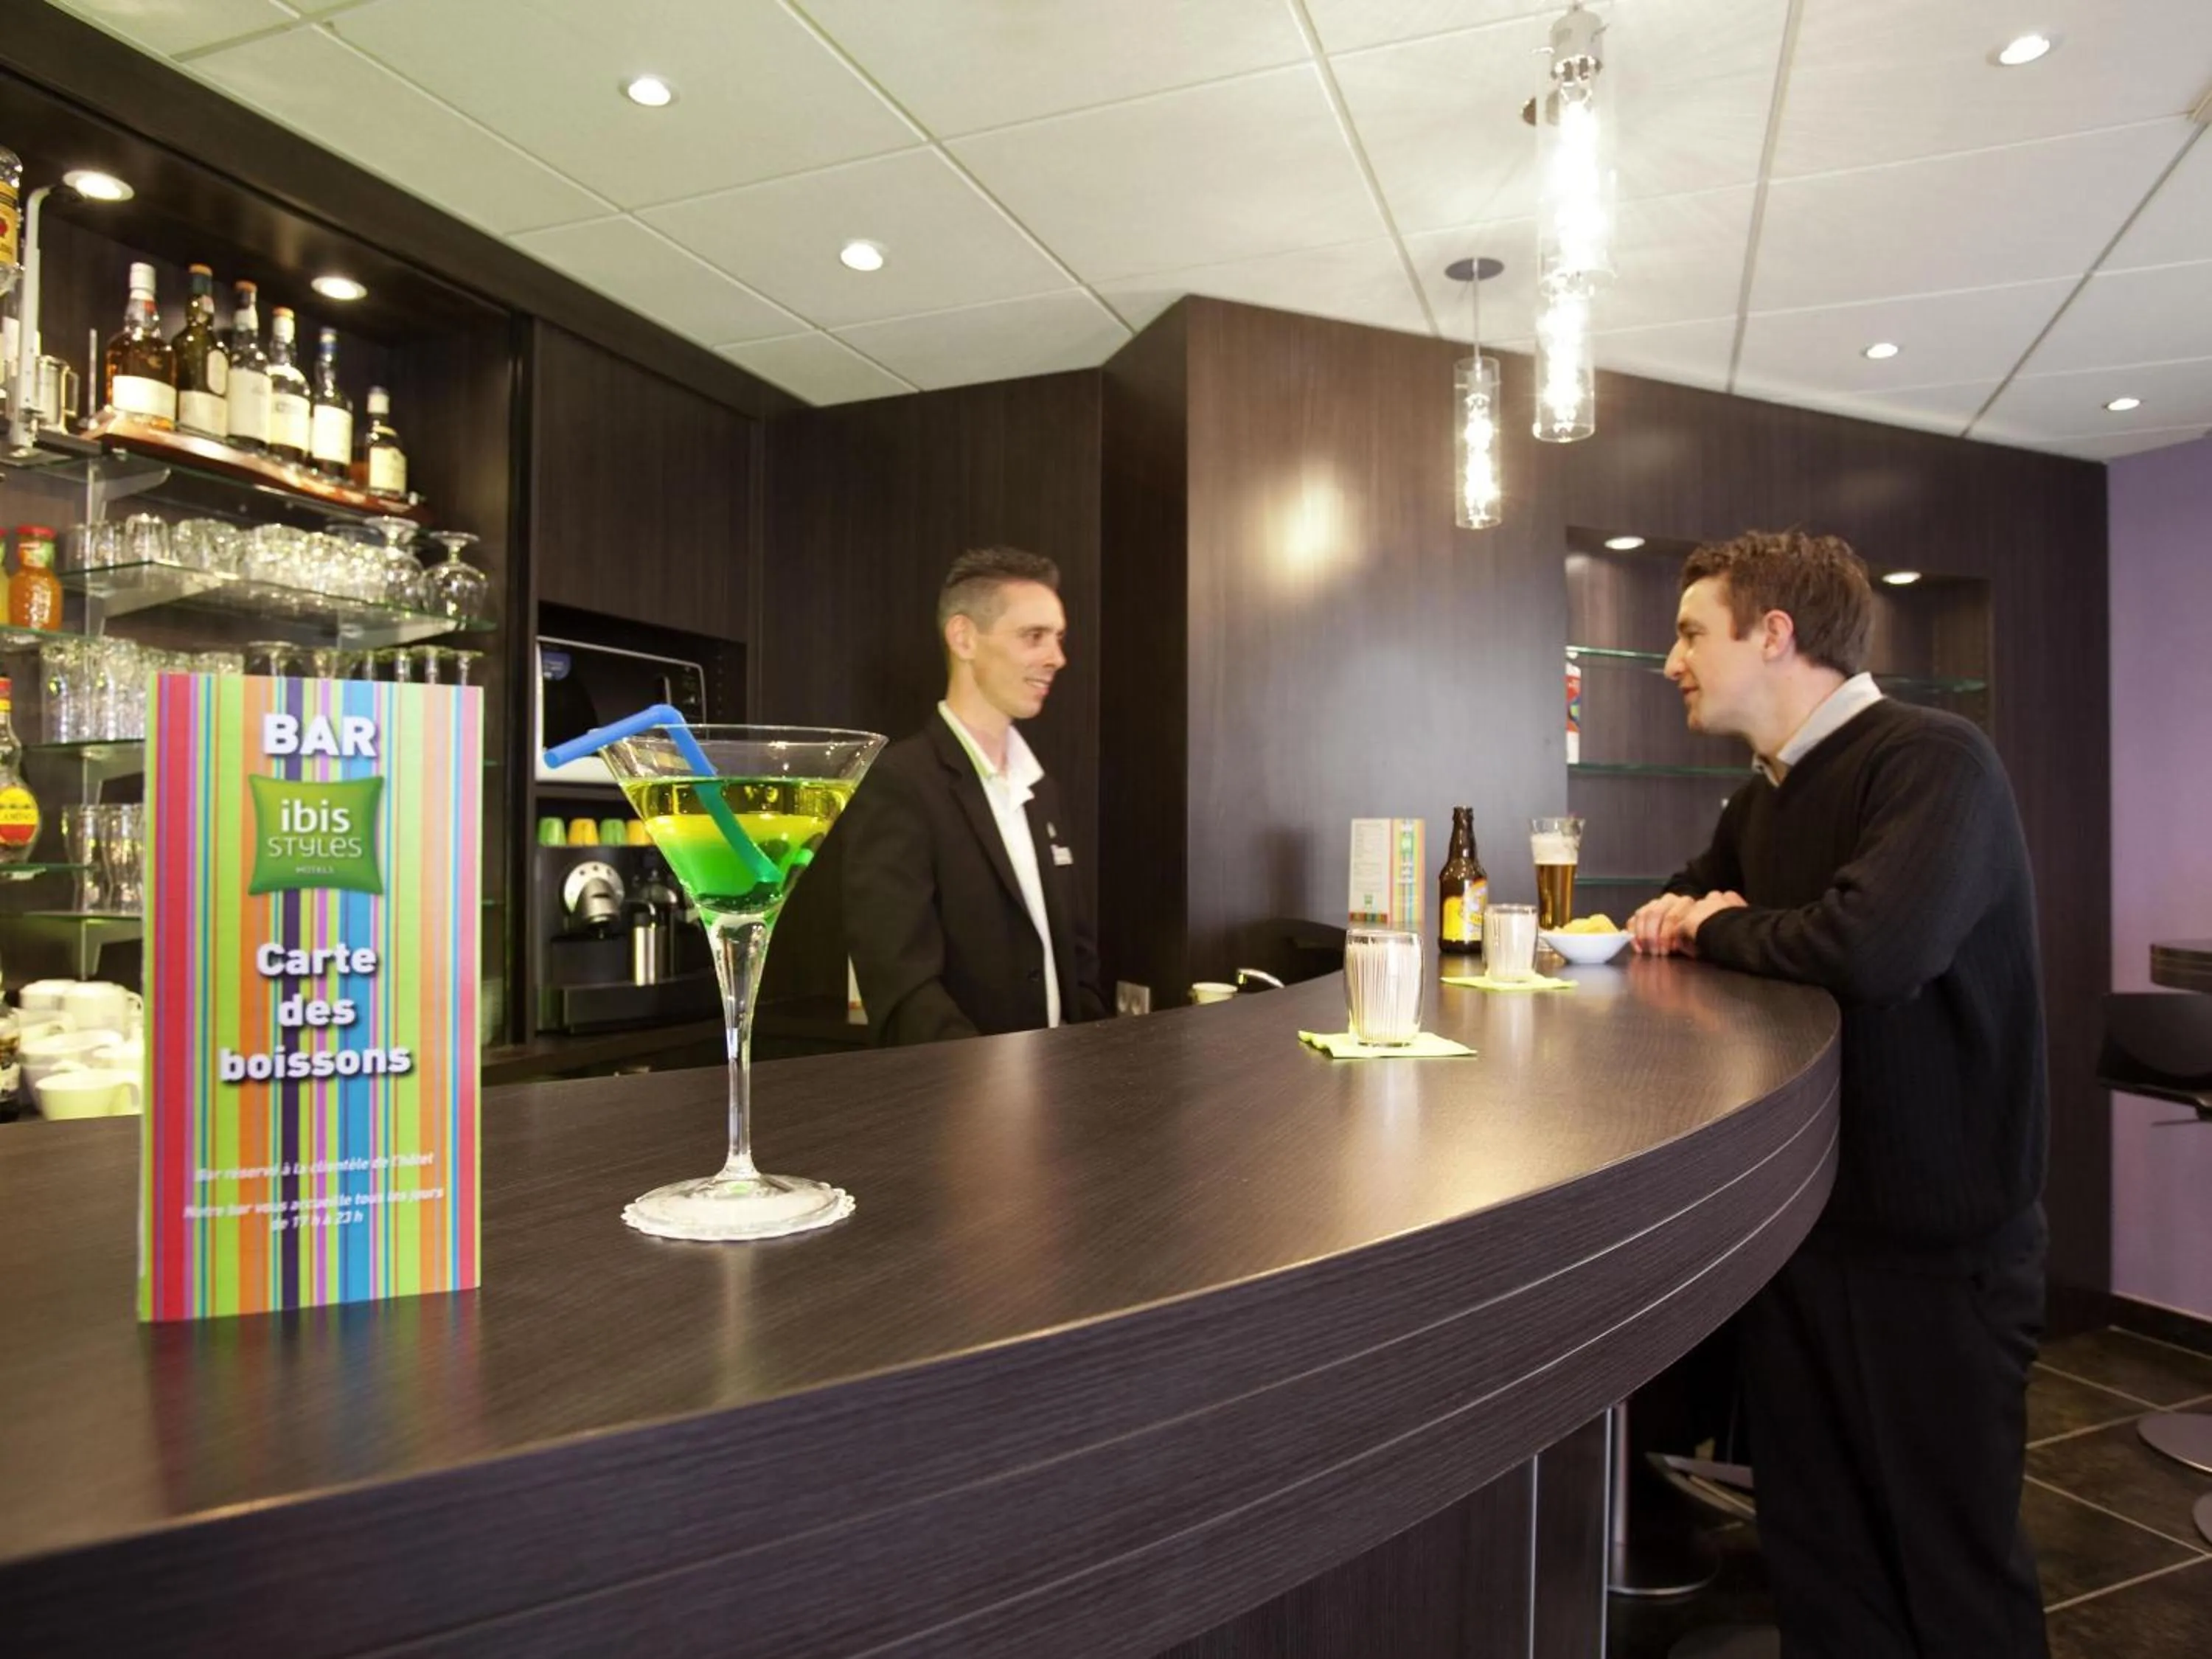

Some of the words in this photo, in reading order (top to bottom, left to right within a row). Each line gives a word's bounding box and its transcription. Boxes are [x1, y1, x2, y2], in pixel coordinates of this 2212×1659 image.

[262, 714, 378, 757] BAR
[281, 799, 350, 833] ibis
[296, 866, 334, 874] HOTELS
[256, 943, 378, 976] Carte
[277, 994, 355, 1027] des
[220, 1046, 411, 1082] boissons
[293, 1161, 307, 1175] la
